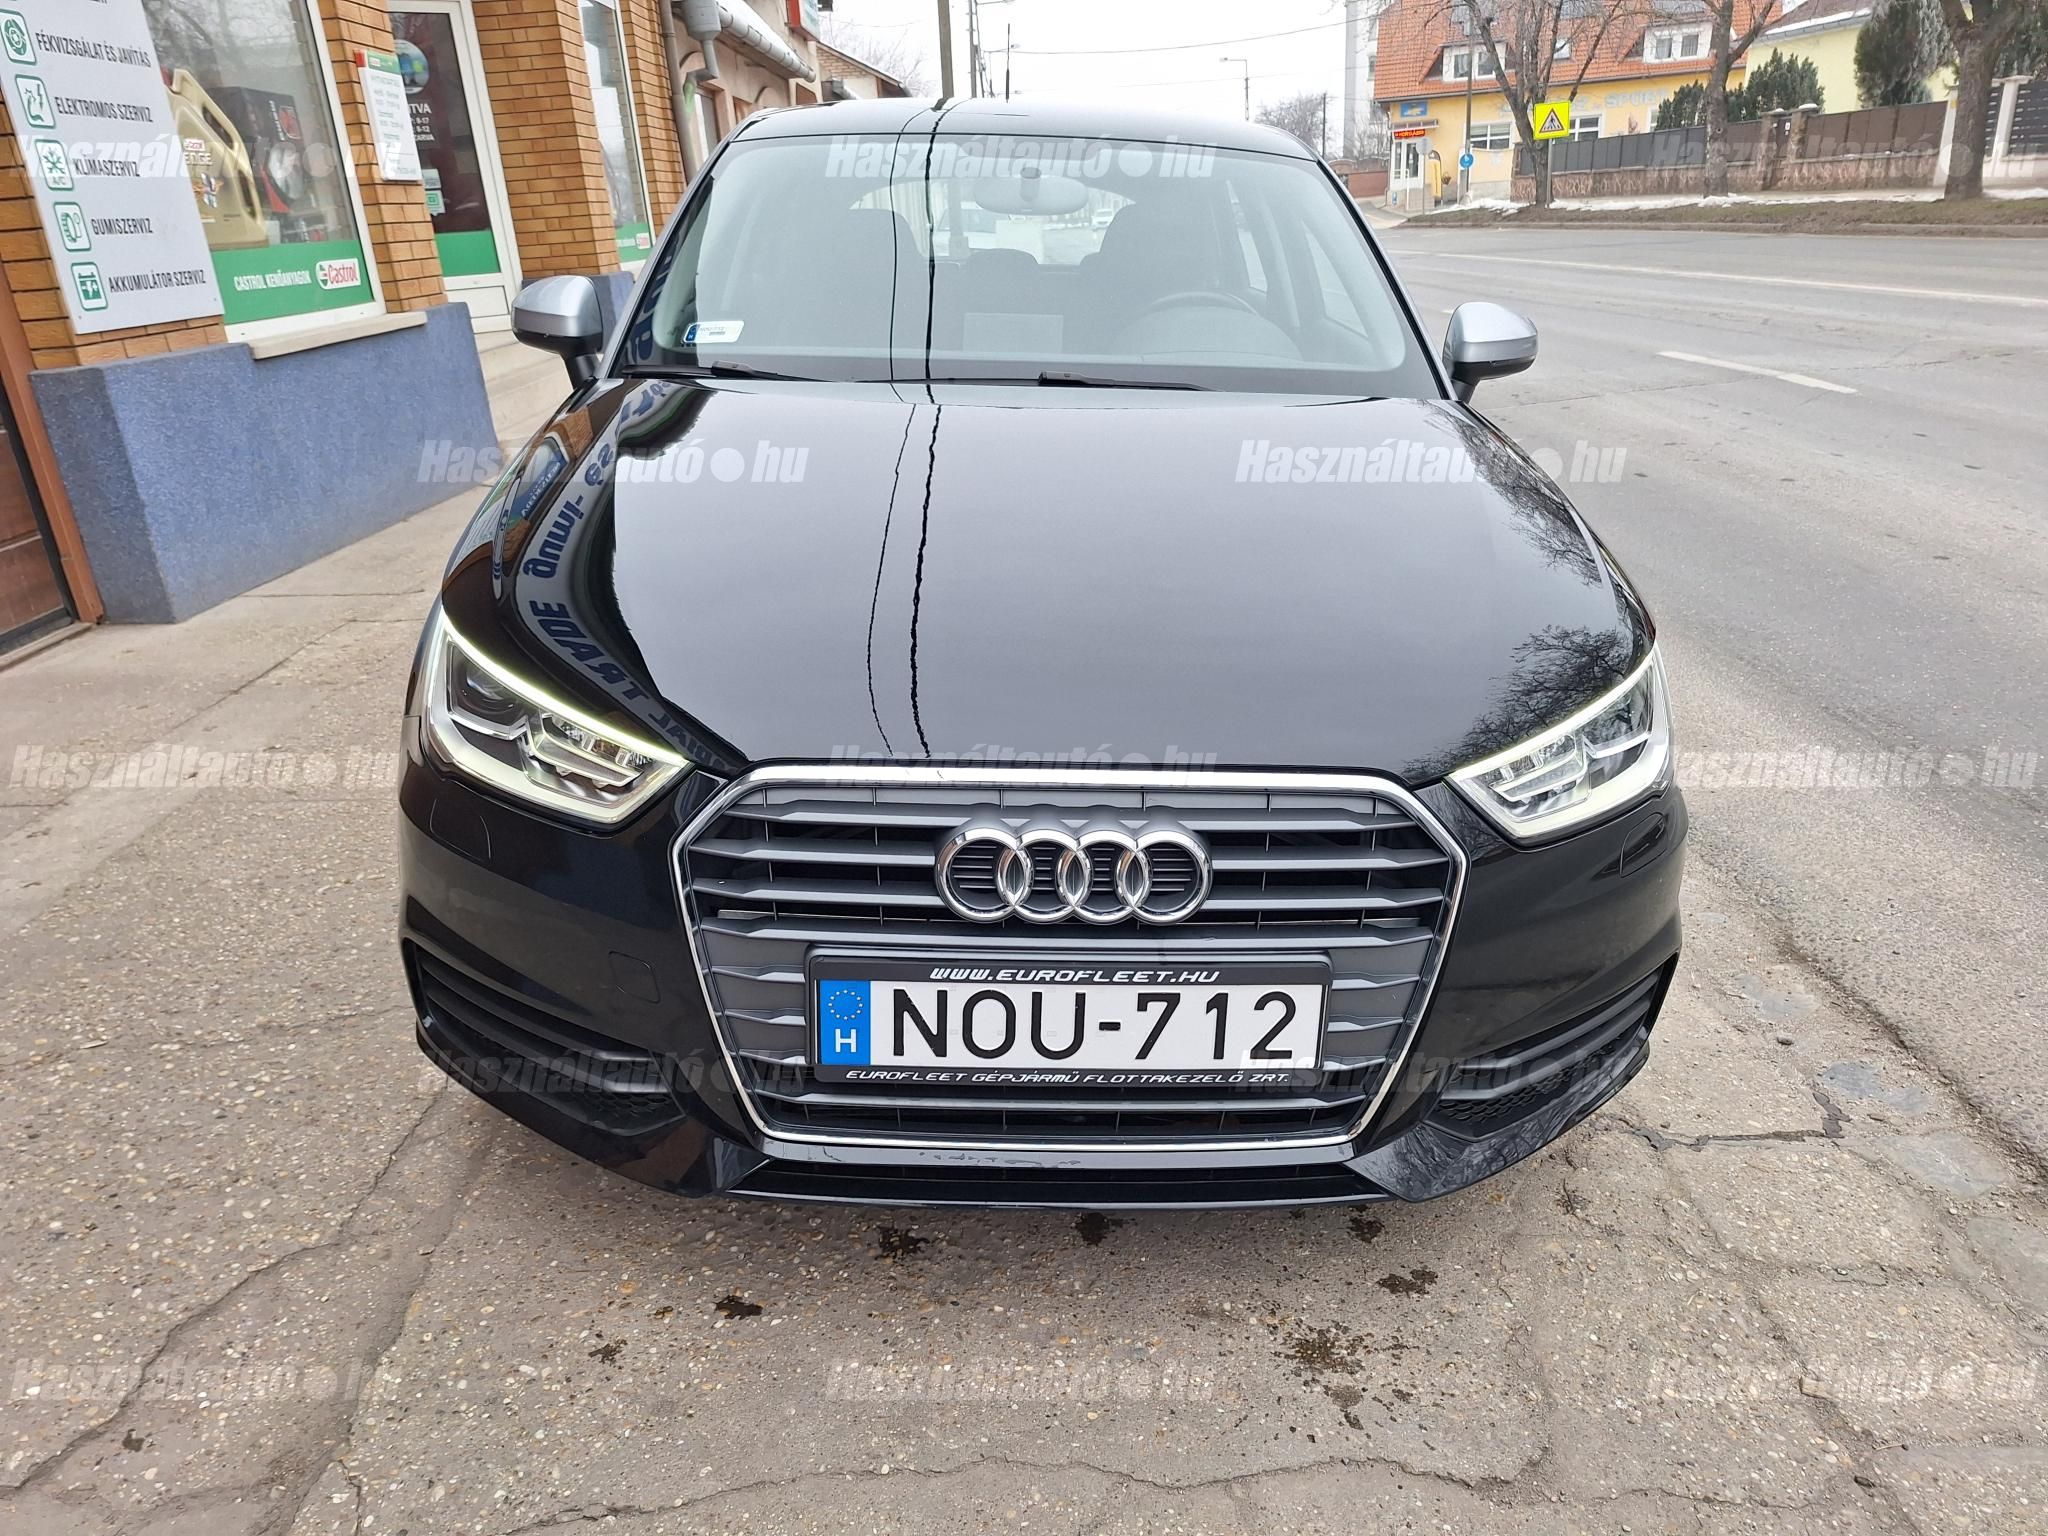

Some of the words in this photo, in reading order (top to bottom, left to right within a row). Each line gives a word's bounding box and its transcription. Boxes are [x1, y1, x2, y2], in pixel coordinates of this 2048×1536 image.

[35, 29, 104, 61] FÉKVIZSGÁLAT
[104, 40, 118, 62] ÉS
[118, 46, 152, 68] JAVÍTÁS
[54, 96, 118, 119] ELEKTROMOS
[118, 103, 153, 123] SZERVIZ
[73, 154, 140, 177] KLÍMASZERVIZ
[91, 218, 153, 235] GUMISZERVIZ
[108, 270, 172, 293] AKKUMULÁTOR
[173, 269, 206, 285] SZERVIZ
[327, 262, 358, 284] Castrol
[929, 967, 1221, 983] WWW.EUROFLEET.HU
[833, 1028, 857, 1054] H
[892, 988, 1297, 1060] NOU-712
[845, 1070, 968, 1082] EUROFLEET
[1082, 1070, 1244, 1083] FLOTTAKEZELŐ
[1248, 1073, 1289, 1082] ZRT.
